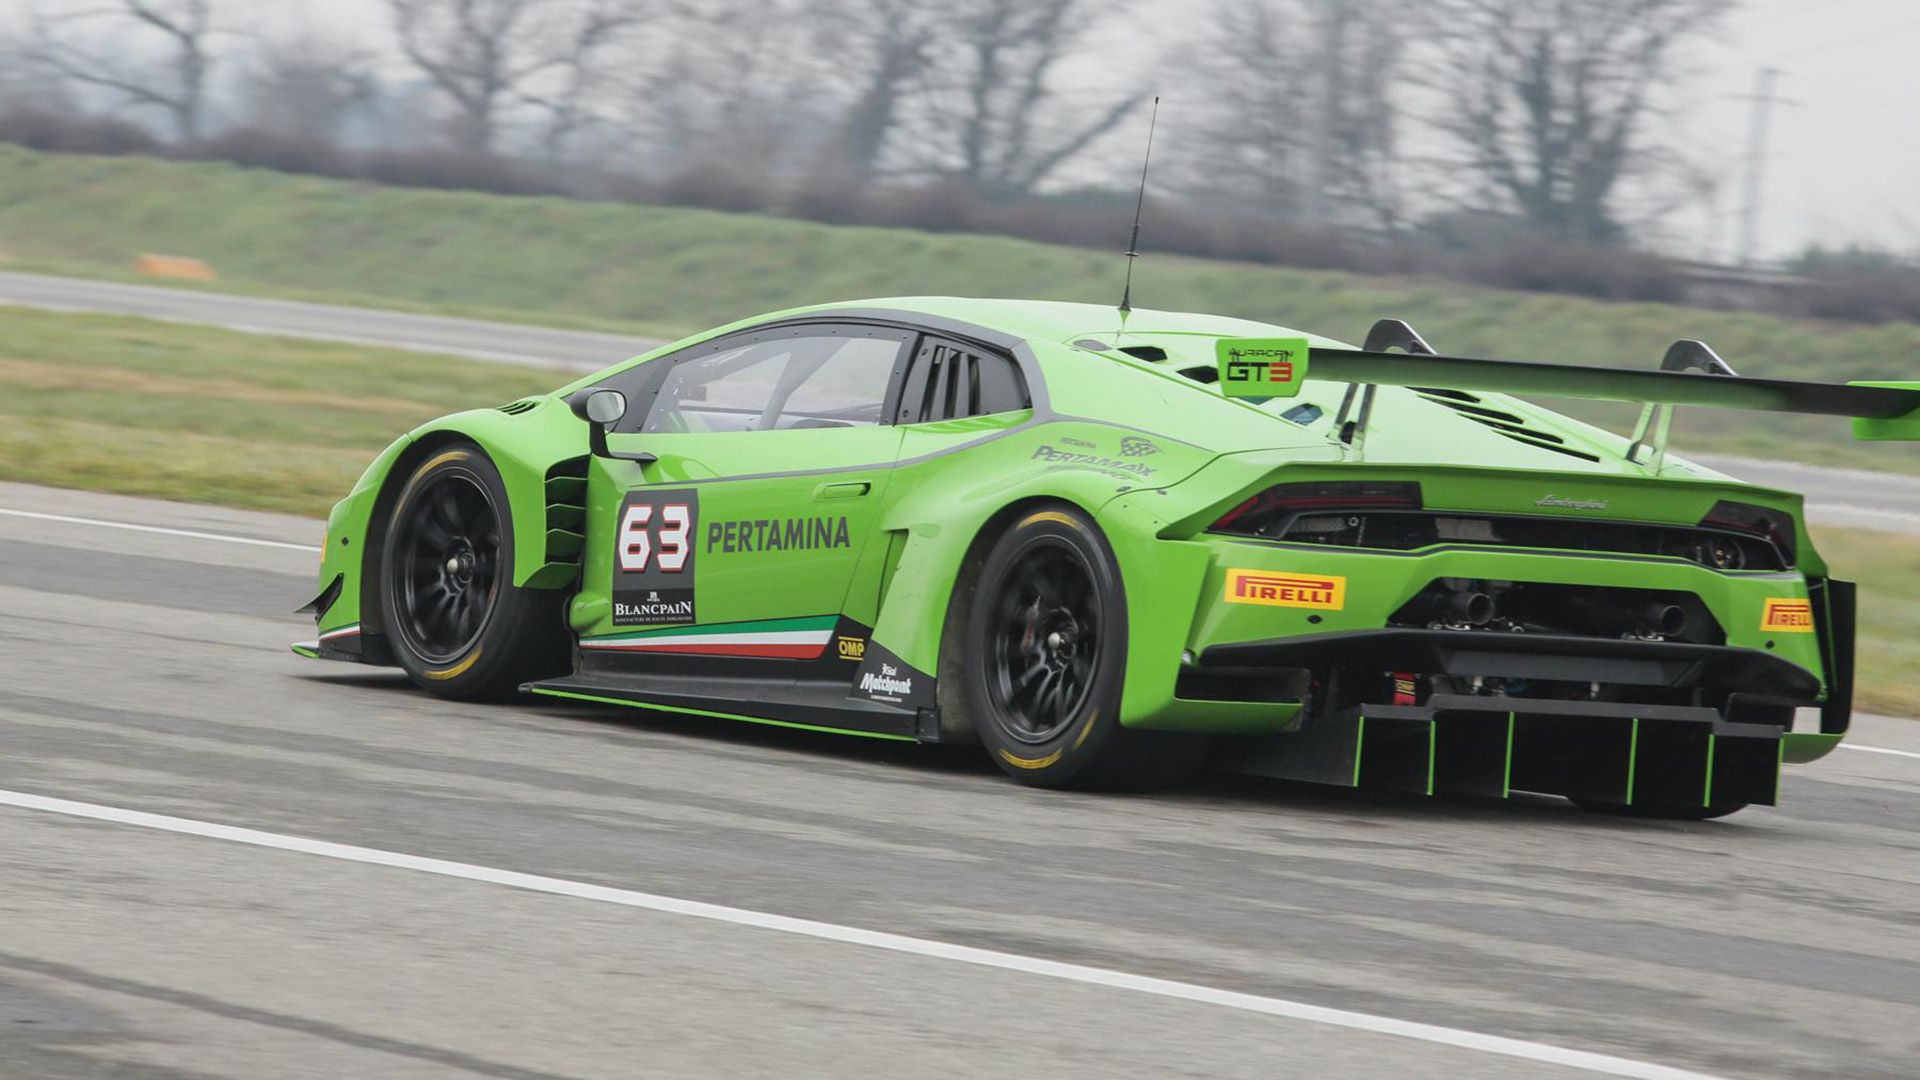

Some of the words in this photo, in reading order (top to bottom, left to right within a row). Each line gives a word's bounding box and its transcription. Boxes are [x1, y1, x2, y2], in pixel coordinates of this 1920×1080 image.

[1227, 362, 1293, 382] GT3
[618, 503, 691, 573] 63
[707, 516, 851, 554] PERTAMINA
[1235, 575, 1335, 604] PIRELLI
[614, 601, 692, 616] BLANCPAIN
[838, 640, 865, 656] OMP
